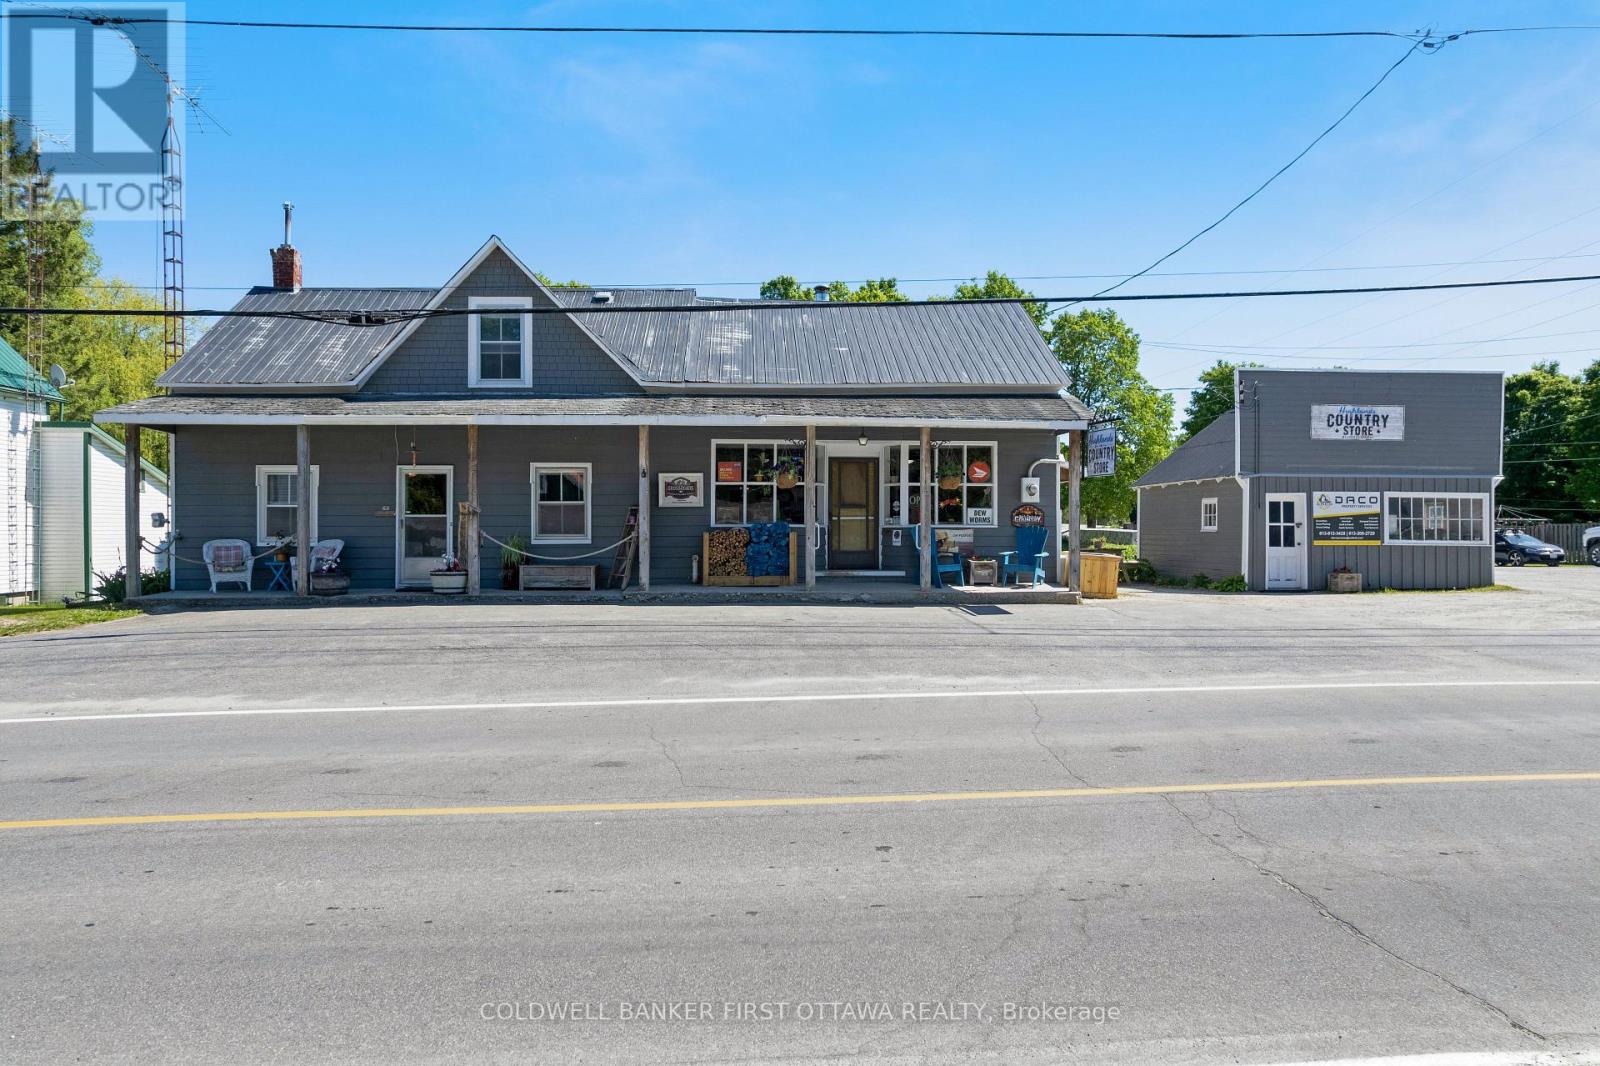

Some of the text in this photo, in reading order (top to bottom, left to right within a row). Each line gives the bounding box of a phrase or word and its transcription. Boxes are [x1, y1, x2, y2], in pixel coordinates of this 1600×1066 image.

[1327, 414, 1389, 428] COUNTRY
[1343, 426, 1373, 436] STORE
[1088, 446, 1115, 463] COUNTRY
[1094, 461, 1109, 474] STORE
[909, 496, 921, 505] OP
[1335, 496, 1378, 504] DACO
